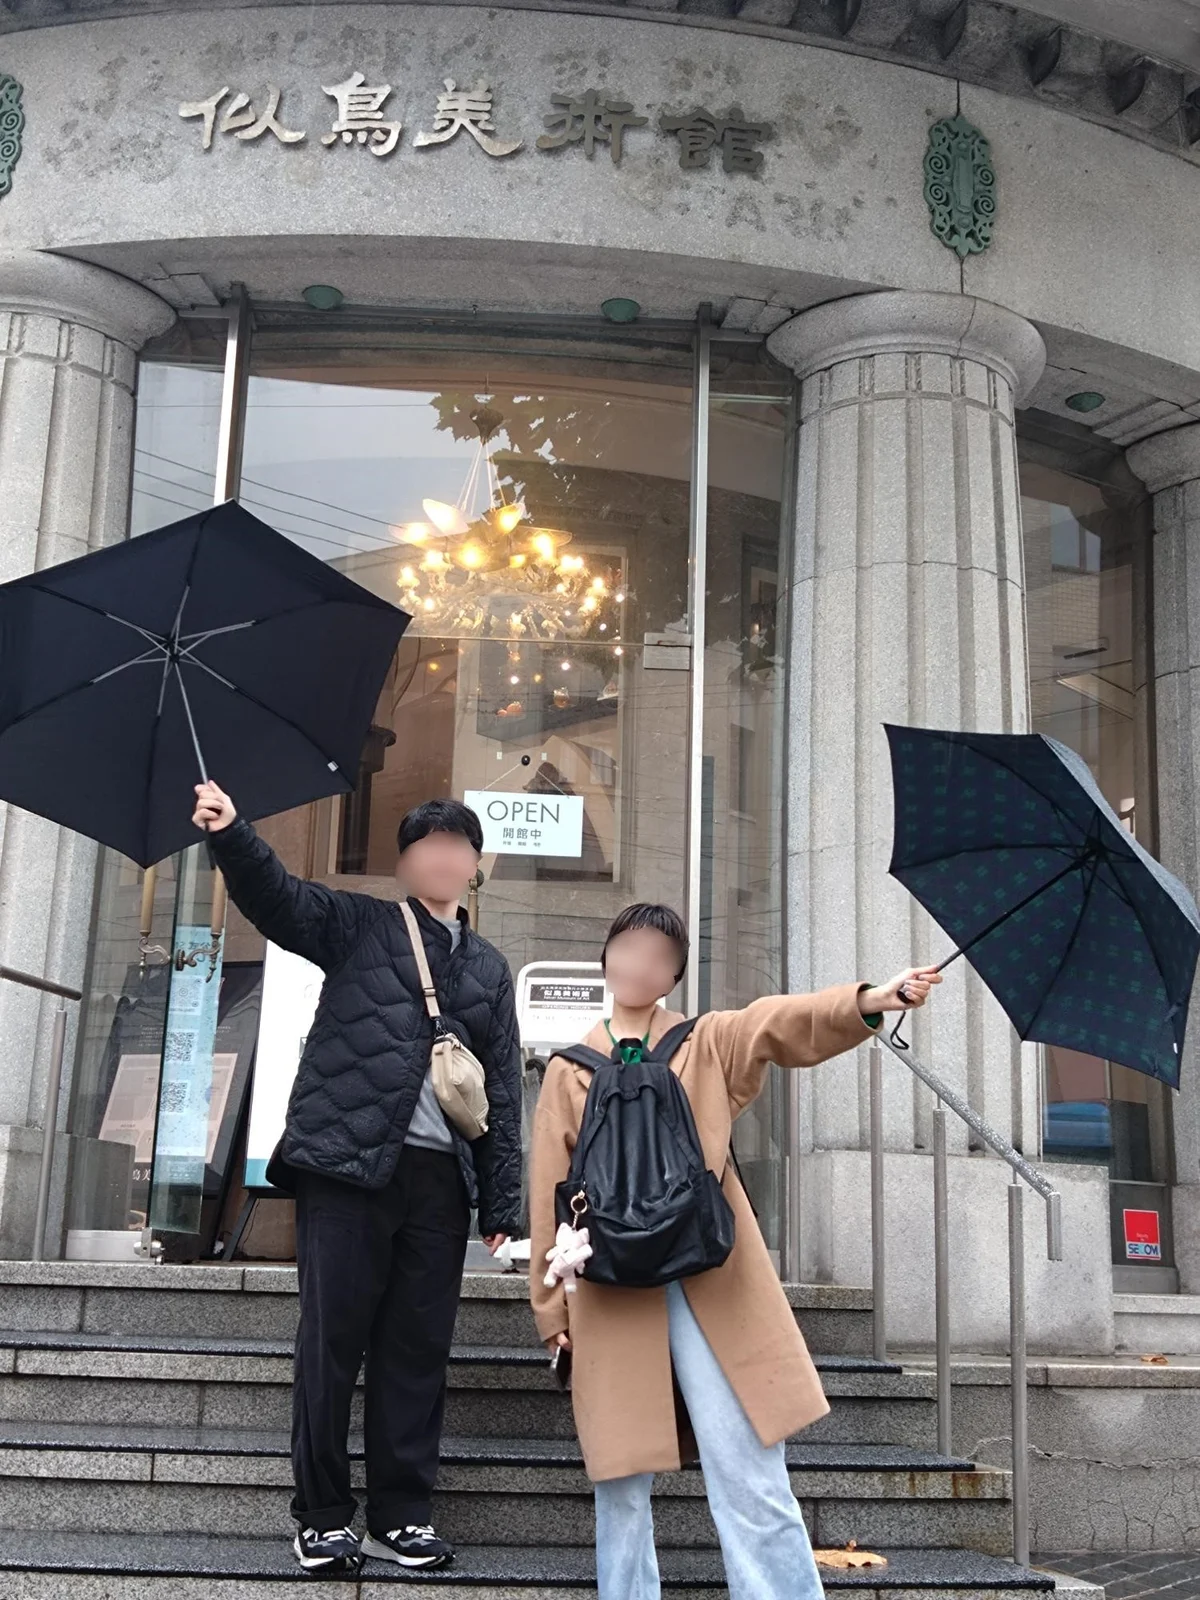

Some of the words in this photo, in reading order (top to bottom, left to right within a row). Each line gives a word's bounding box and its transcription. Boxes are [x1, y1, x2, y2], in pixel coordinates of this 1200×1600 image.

[179, 71, 773, 173] 似鳥美術館
[487, 800, 560, 824] OPEN
[503, 827, 542, 840] 開館中
[1128, 1243, 1159, 1255] SECOM
